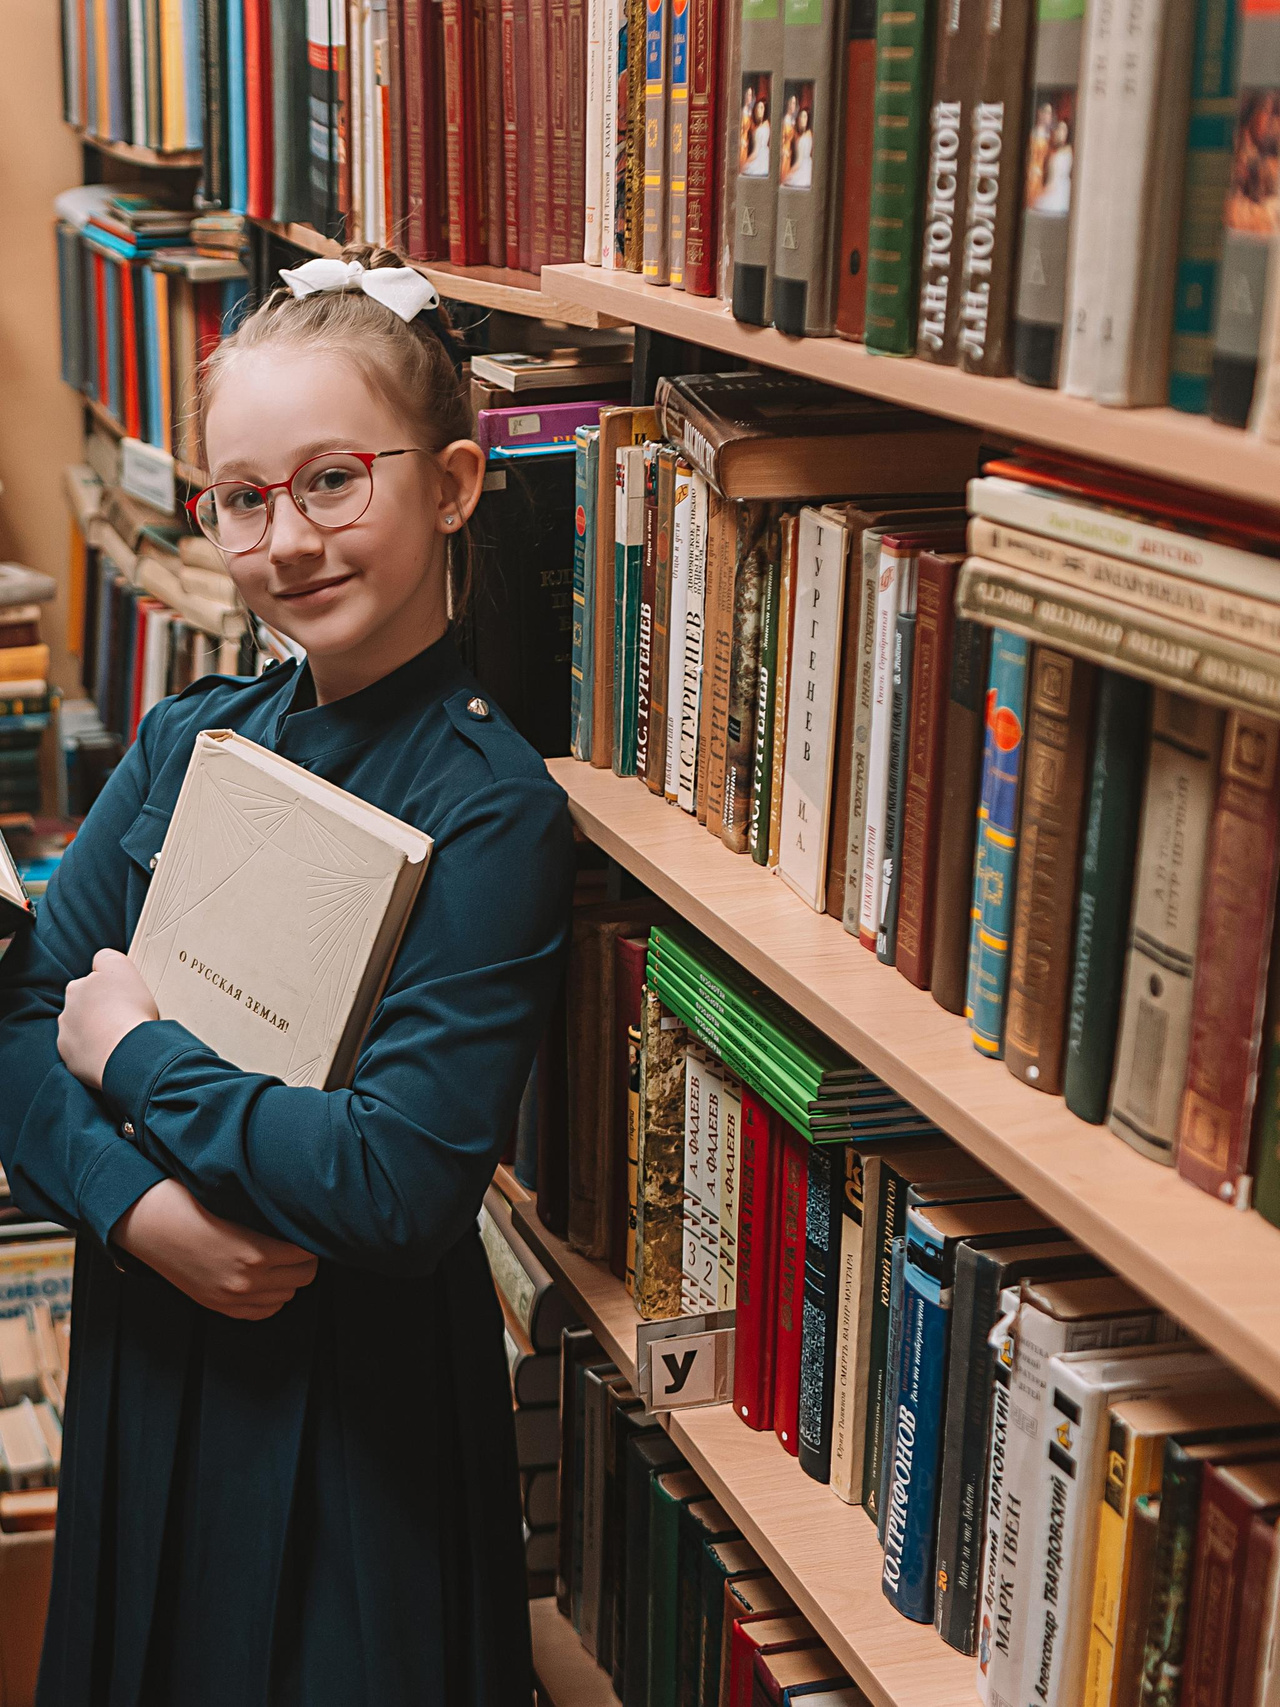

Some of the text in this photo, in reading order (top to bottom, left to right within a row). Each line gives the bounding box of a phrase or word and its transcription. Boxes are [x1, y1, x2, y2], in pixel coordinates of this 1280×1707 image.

[919, 100, 961, 350] Л.Н. ТОЛСТОЙ
[959, 101, 1005, 360] Л.Н. ТОЛСТОЙ
[672, 556, 680, 580] Отцы
[976, 581, 1035, 615] ЮНОСТЬ
[802, 525, 824, 762] ТУРГЕНЕВ
[863, 578, 876, 655] СЕРЕБРЯНЫЙ
[637, 602, 652, 720] ТУРГЕНЕВ
[680, 610, 702, 742] ТУРГЕНЕВ
[709, 630, 731, 763] ТУРГЕНЕВ
[636, 726, 648, 772] И.С.
[865, 824, 877, 871] ТОЛСТОЙ
[877, 609, 889, 671] Серебряный
[727, 765, 737, 833] охотника
[1071, 890, 1096, 1013] ТОЛСТОЙ
[179, 950, 291, 1034] О РУССКАЯ ЗЕМЛЯ!
[688, 1076, 700, 1180] А. ФАДЕЕВ
[706, 1092, 719, 1199] А. ФАДЕЕВ
[725, 1112, 736, 1219] А. ФАДЕЕВ
[688, 1241, 697, 1266] 3
[741, 1222, 753, 1279] МАРК
[883, 1179, 897, 1255] ТЫНЯНОВ
[703, 1261, 713, 1286] 2
[841, 1253, 854, 1342] ВАЗИР-МУХТАРА
[881, 1257, 893, 1308] ЮРИЙ
[839, 1344, 849, 1387] СМЕРТЬ
[913, 1297, 926, 1366] набережной
[660, 1350, 698, 1395] У
[837, 1390, 847, 1431] Тынянов
[963, 1523, 973, 1544] что
[983, 1379, 1011, 1612] Арсений ТАРКОВСКИЙ
[938, 1570, 948, 1592] 20
[958, 1561, 970, 1589] Мало
[995, 1490, 1022, 1659] МАРК ТВЕН
[1034, 1473, 1068, 1704] Александр ТВАРДОВСКИЙ
